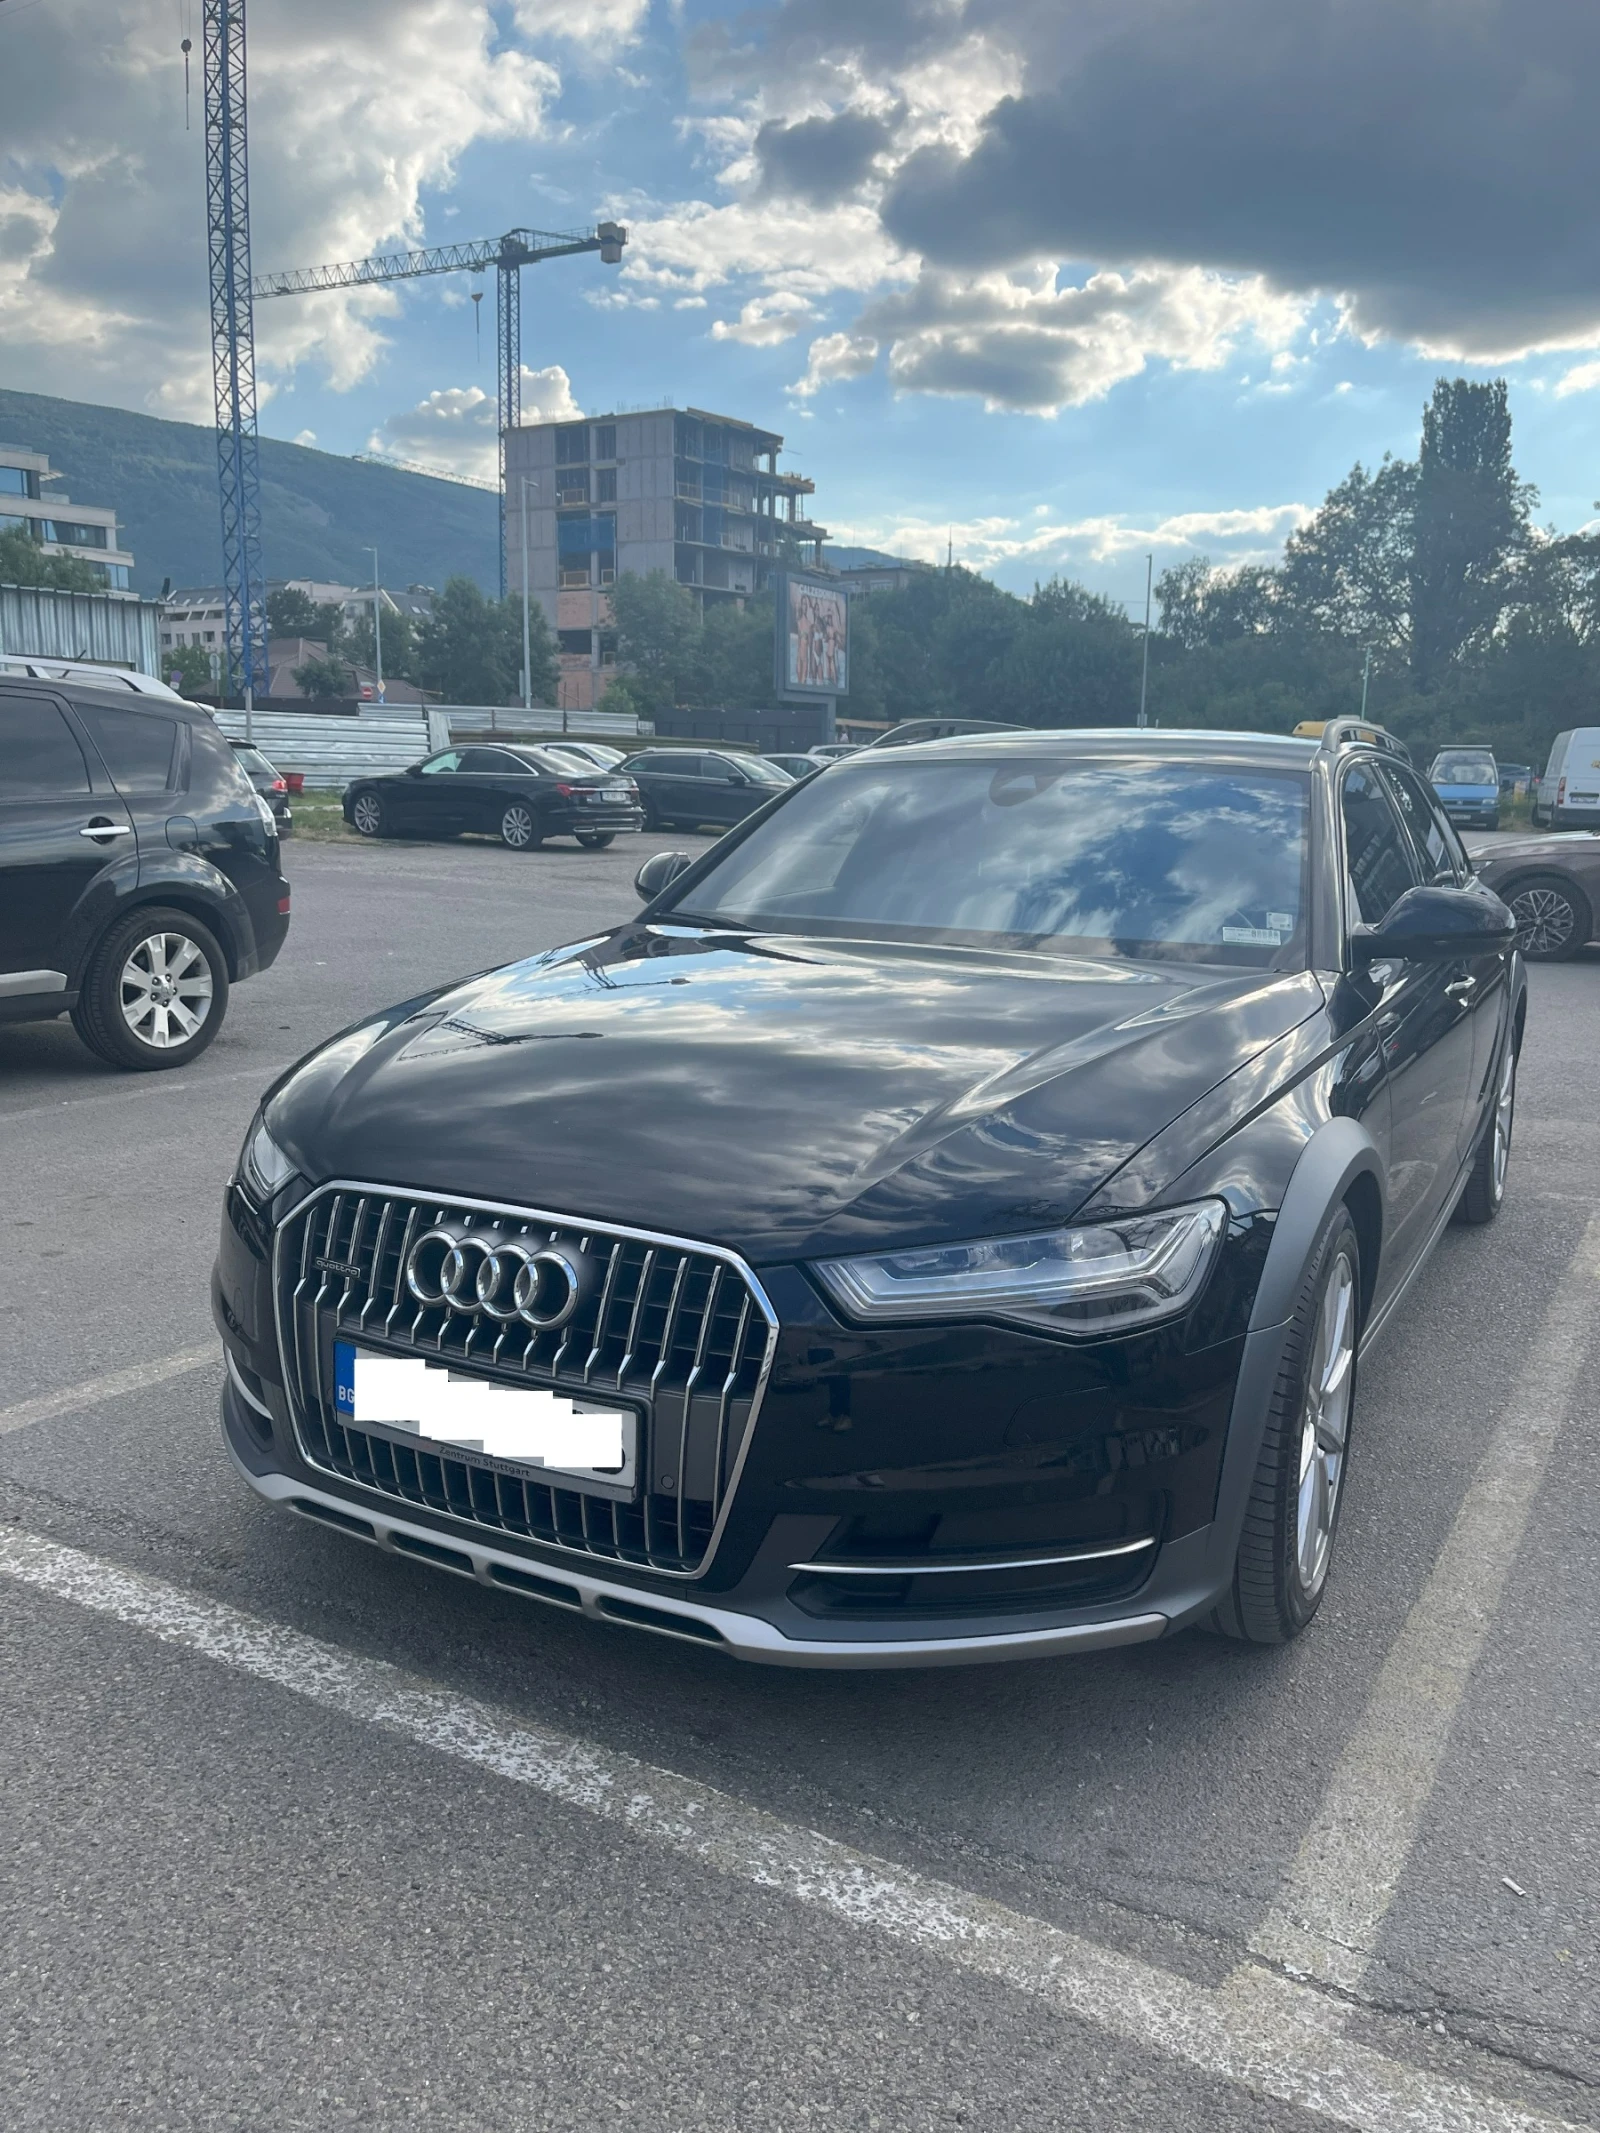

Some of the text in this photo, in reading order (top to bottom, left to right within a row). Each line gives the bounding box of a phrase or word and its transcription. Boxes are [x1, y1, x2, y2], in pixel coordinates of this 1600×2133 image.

[316, 1260, 358, 1276] quattro
[439, 1446, 531, 1477] Zentrum Stuttgart
